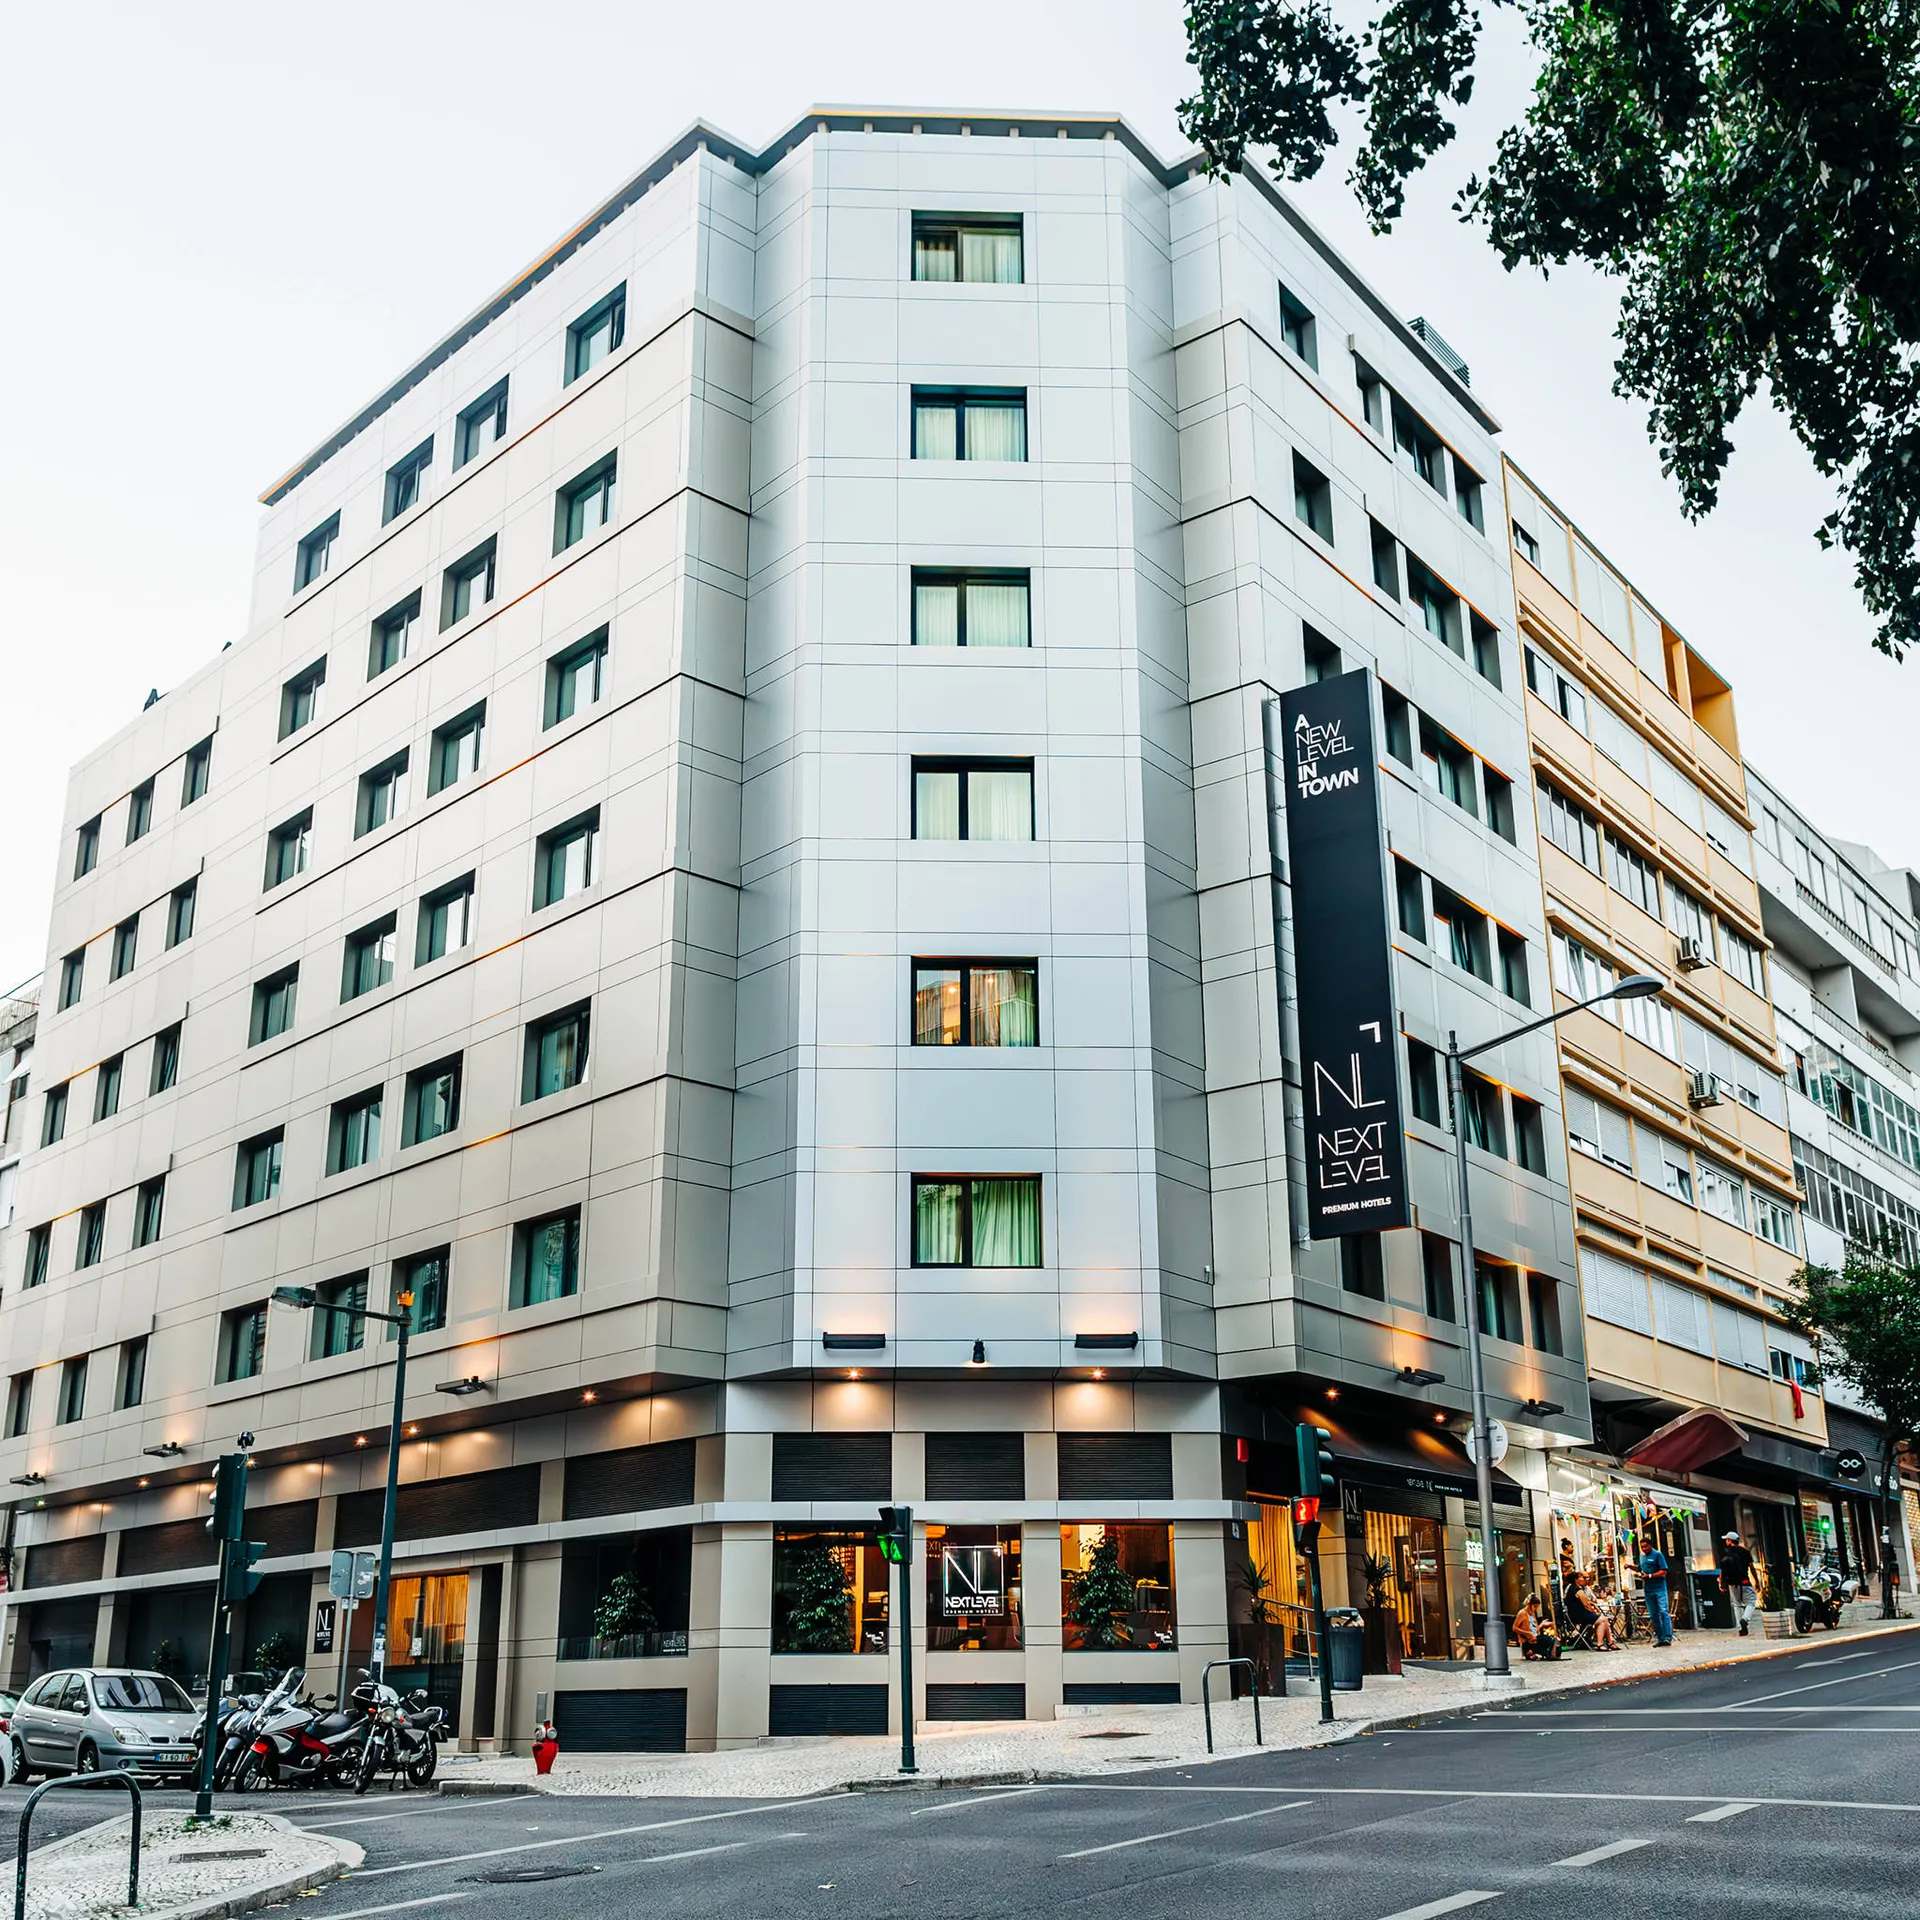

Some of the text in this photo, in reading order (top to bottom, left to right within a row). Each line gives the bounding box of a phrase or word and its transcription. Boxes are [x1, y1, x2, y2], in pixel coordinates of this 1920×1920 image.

[1294, 713, 1311, 733] A
[1296, 719, 1342, 749] NEW
[1296, 735, 1355, 766] LEVEL
[1297, 761, 1319, 783] IN
[1297, 767, 1359, 799] TOWN
[1313, 1052, 1386, 1117] NL
[1318, 1121, 1387, 1160] NEXT
[1320, 1154, 1390, 1189] LEVEL
[1322, 1196, 1392, 1215] PREMIUM HOTELS
[945, 1550, 999, 1595] NL
